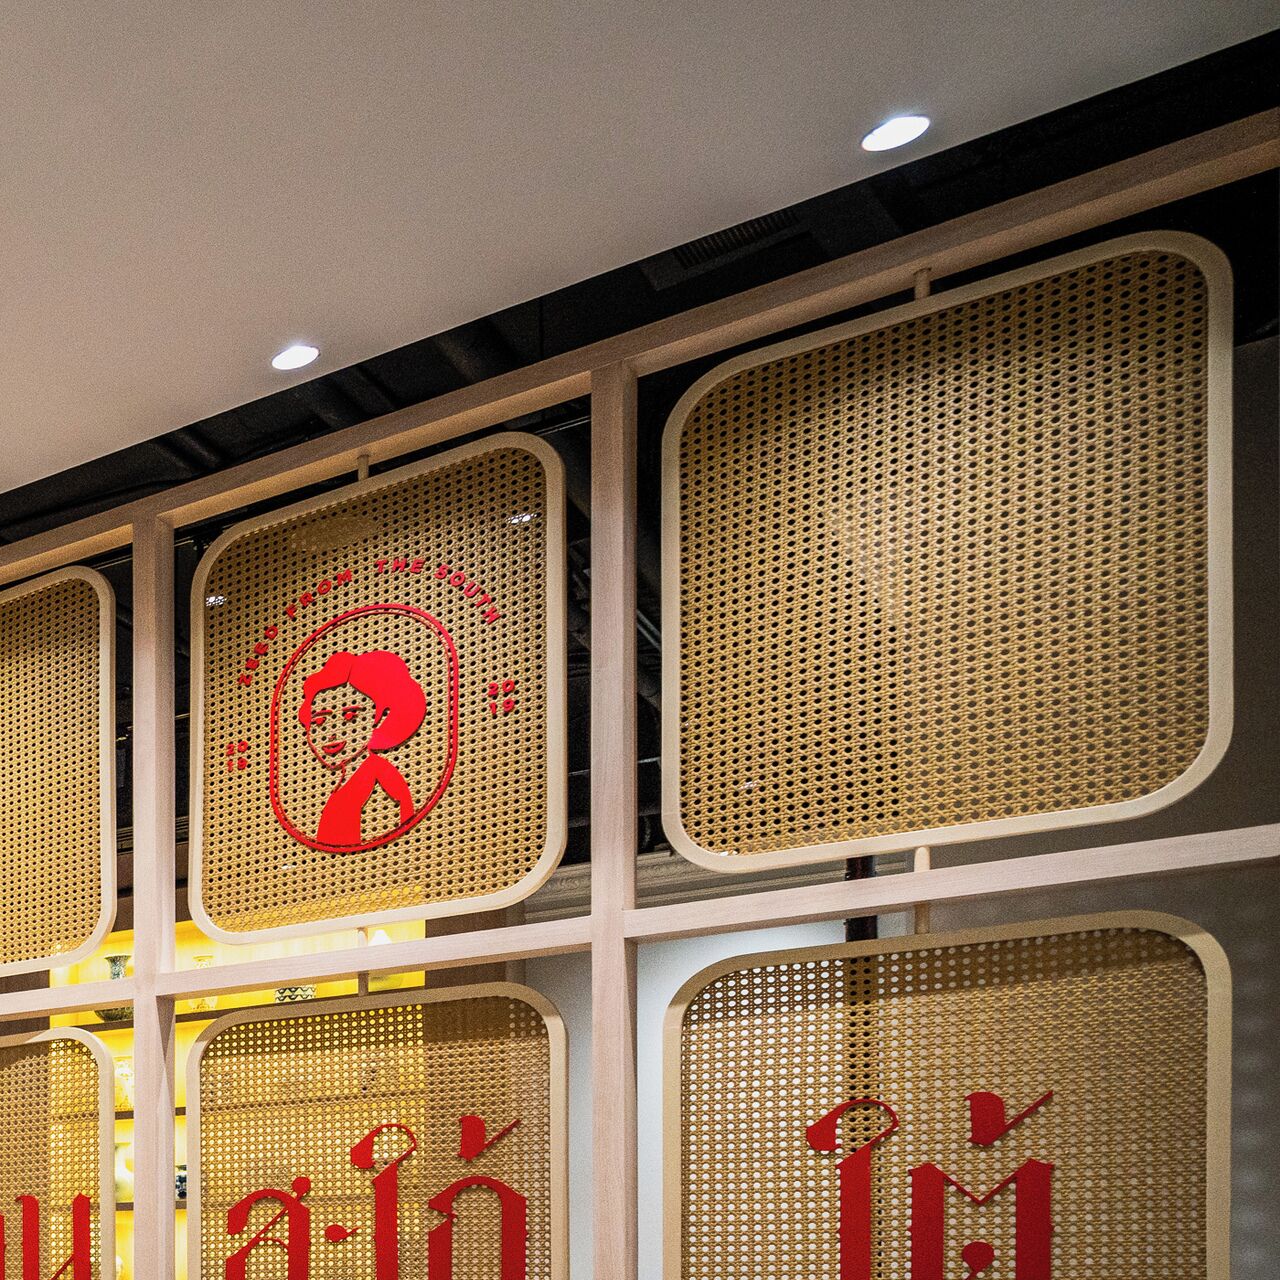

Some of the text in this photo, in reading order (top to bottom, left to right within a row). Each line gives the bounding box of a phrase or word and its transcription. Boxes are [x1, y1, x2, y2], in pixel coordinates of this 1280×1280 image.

[285, 569, 353, 620] FROM
[375, 558, 425, 574] THE
[434, 564, 502, 625] SOUTH
[488, 679, 515, 697] 20
[489, 698, 515, 715] 19
